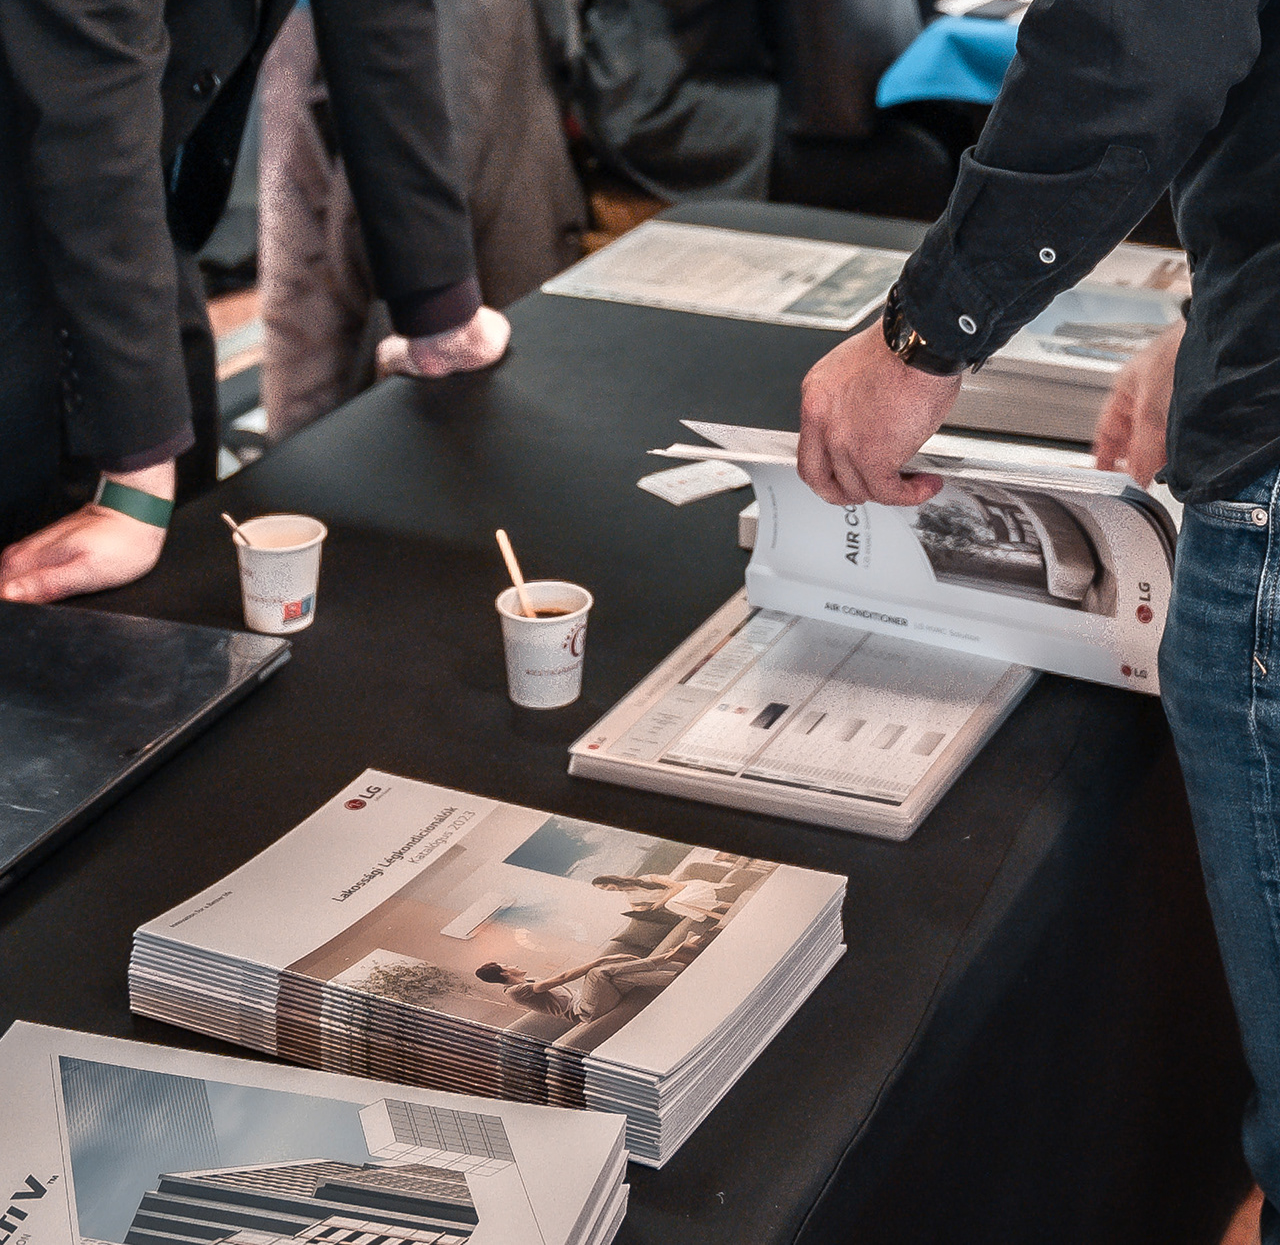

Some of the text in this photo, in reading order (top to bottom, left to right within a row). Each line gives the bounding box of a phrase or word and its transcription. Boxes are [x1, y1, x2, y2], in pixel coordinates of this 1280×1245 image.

[844, 530, 861, 566] AIR
[1138, 581, 1151, 602] LG
[358, 785, 382, 799] LG
[332, 806, 458, 903] Lakossági Légkondicionálók
[407, 810, 476, 865] Katalógus 2023
